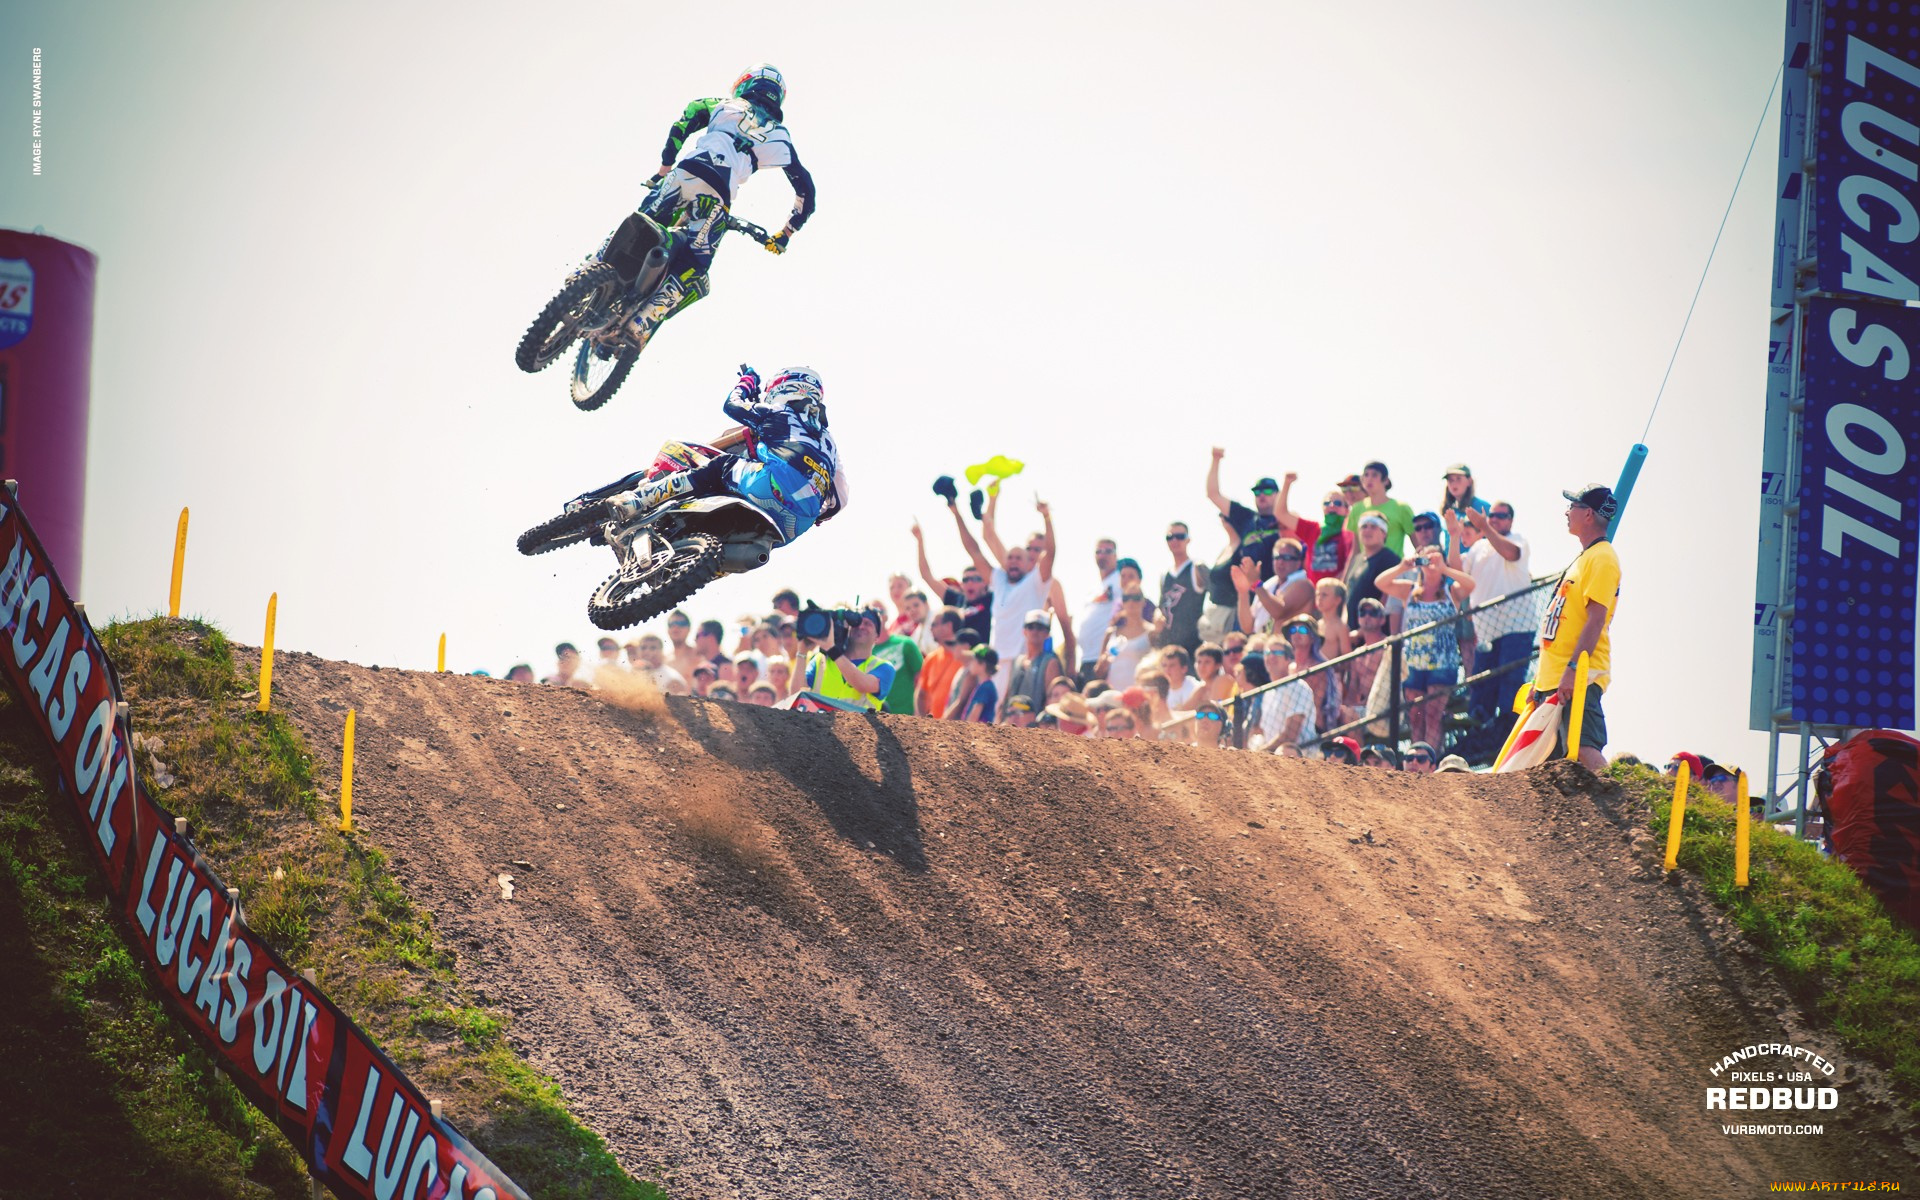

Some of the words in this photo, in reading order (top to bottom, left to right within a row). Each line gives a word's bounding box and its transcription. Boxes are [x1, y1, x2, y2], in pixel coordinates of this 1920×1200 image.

[1829, 34, 1920, 382] LUCAS
[1820, 402, 1907, 560] OIL
[0, 504, 91, 740] UCAS
[75, 699, 127, 856] OIL
[135, 830, 253, 1043] LUCAS
[253, 969, 318, 1109] OIL
